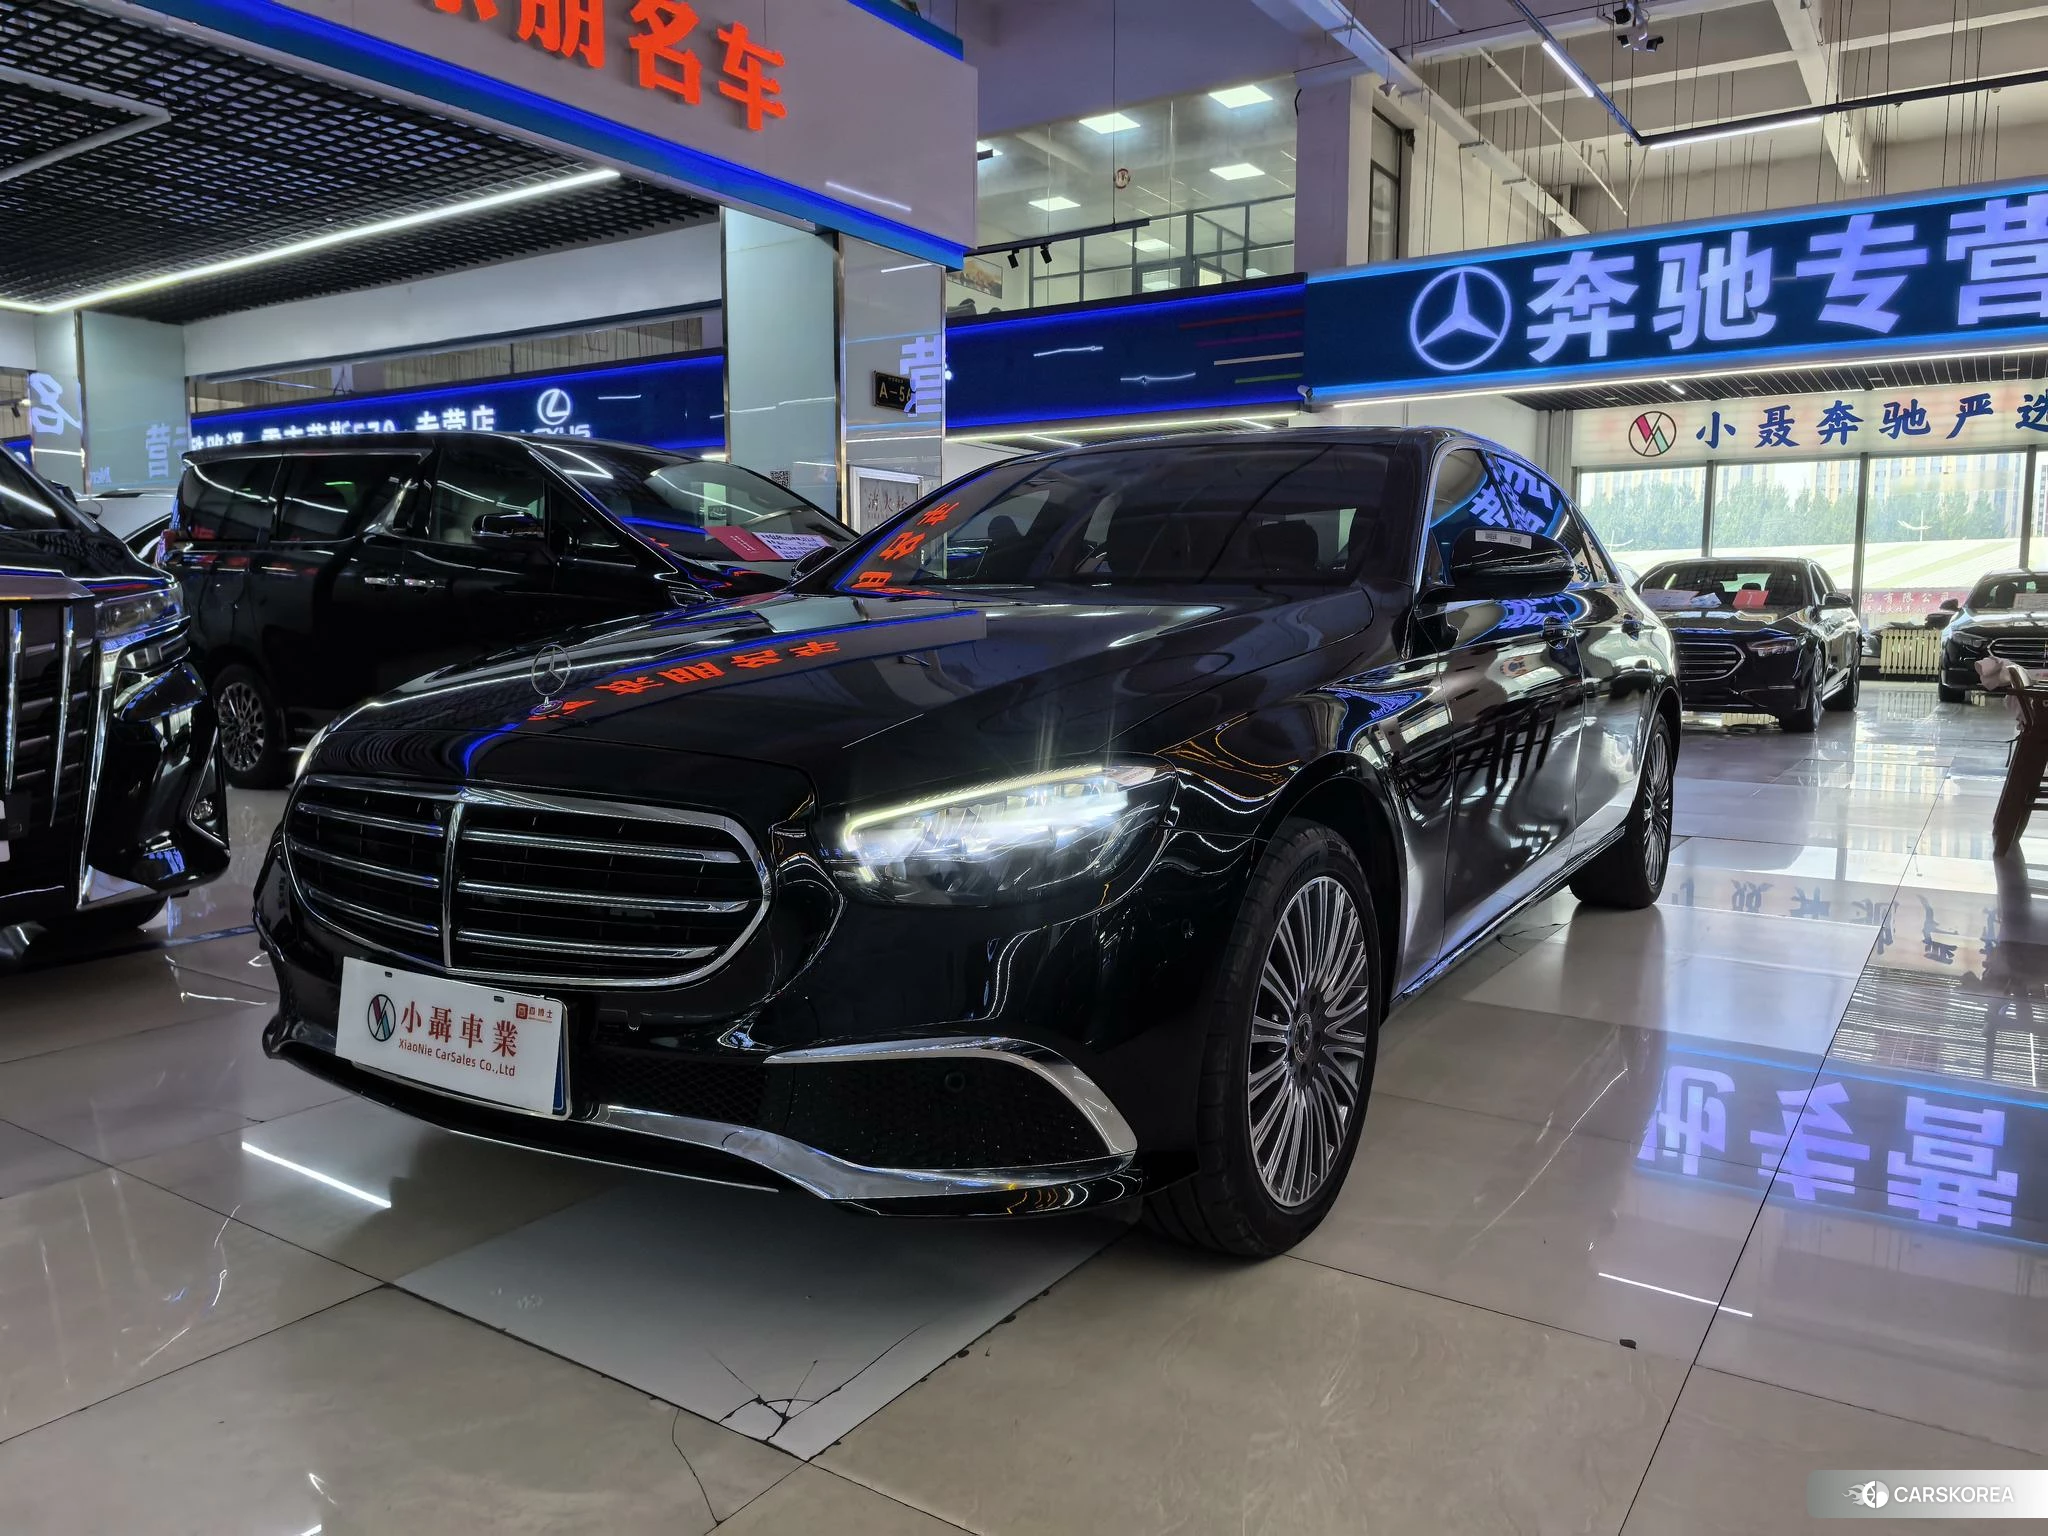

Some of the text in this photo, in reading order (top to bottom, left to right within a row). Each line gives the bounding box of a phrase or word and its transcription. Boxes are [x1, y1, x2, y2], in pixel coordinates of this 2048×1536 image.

[434, 0, 787, 131] 朋名车
[1526, 193, 2048, 364] 奔驰专营
[1696, 393, 2048, 450] 小聂奔驰严选
[399, 1038, 516, 1077] XiaoNie CarSales Co.,Ltd
